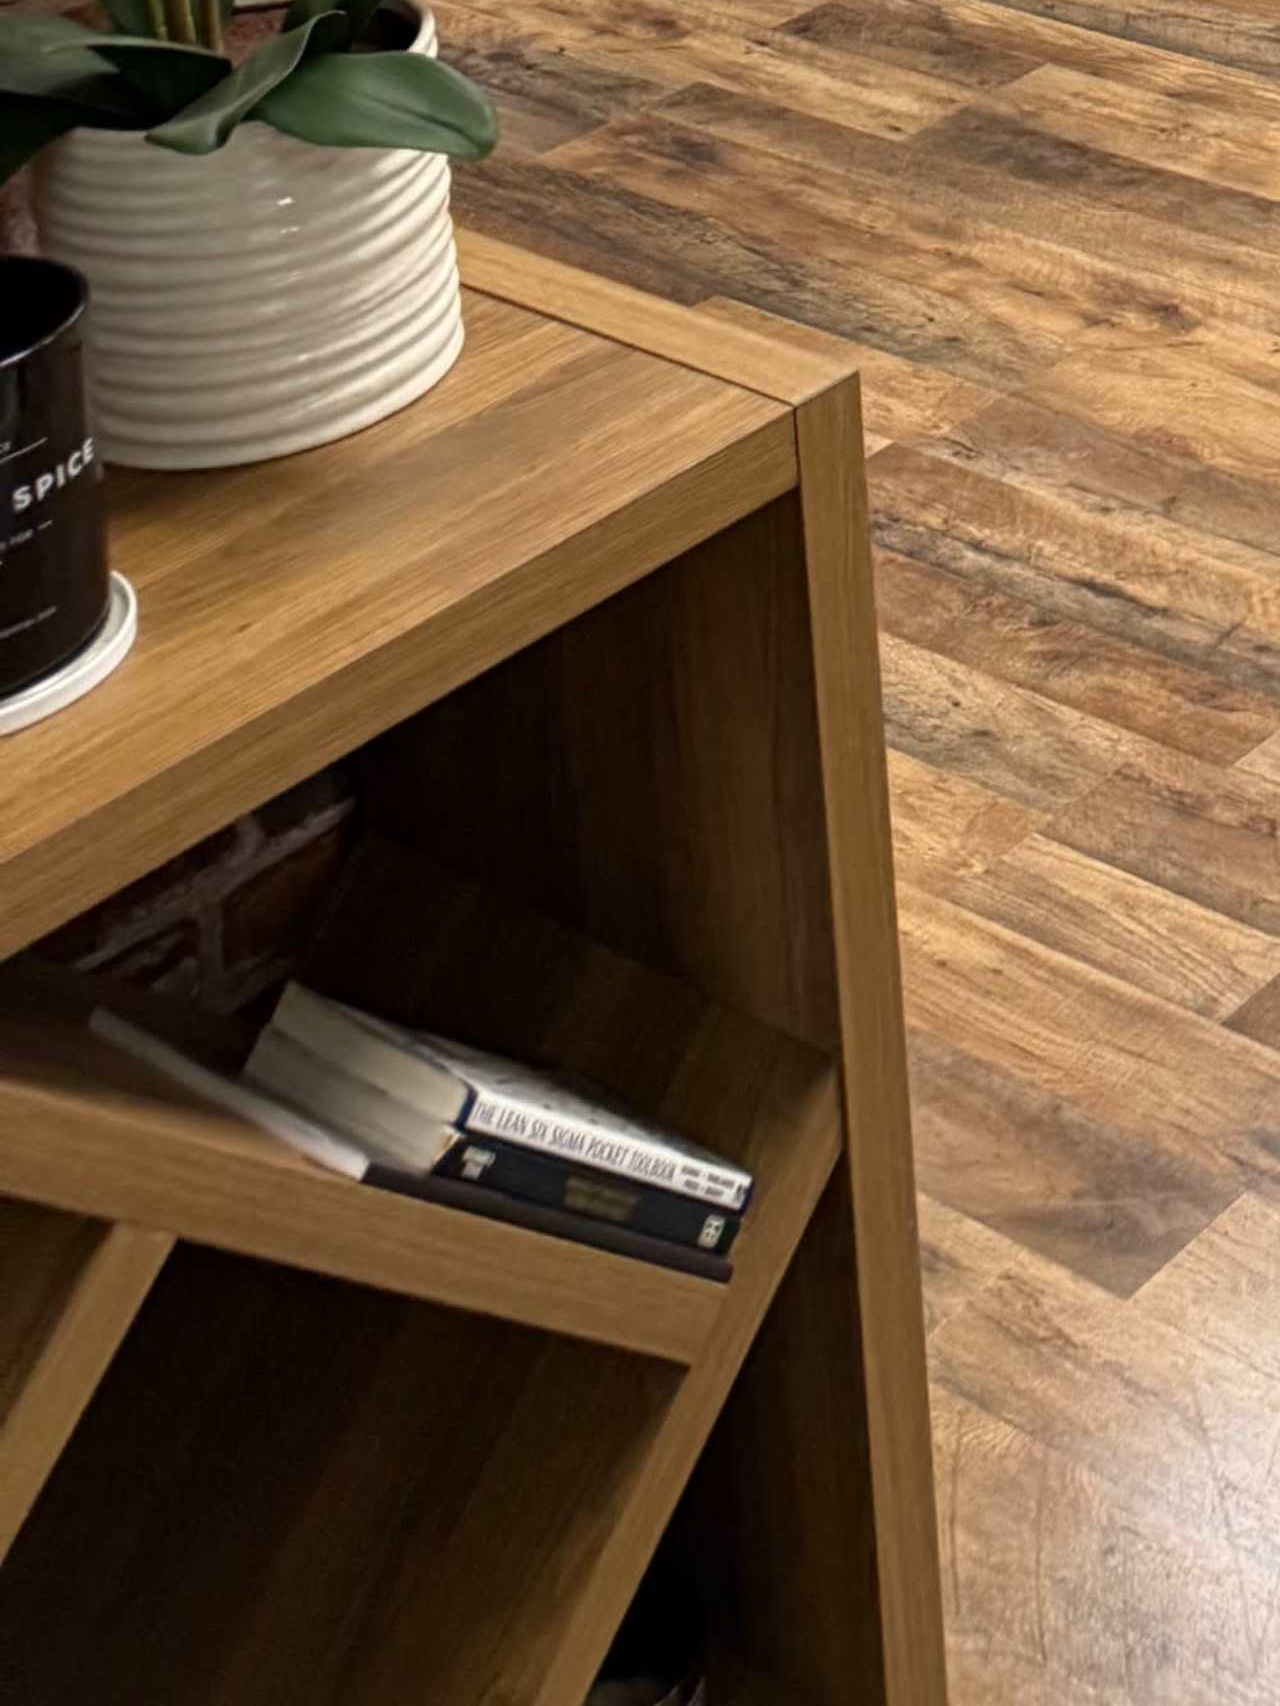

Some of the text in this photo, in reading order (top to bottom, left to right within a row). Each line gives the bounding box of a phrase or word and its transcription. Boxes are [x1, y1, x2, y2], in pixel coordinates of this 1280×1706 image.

[12, 437, 96, 513] SPICE
[474, 1101, 495, 1124] THE
[498, 1104, 528, 1134] LEAN
[530, 1114, 548, 1138] SIX
[550, 1124, 587, 1151] SIGMA
[585, 1135, 629, 1166] POCKET
